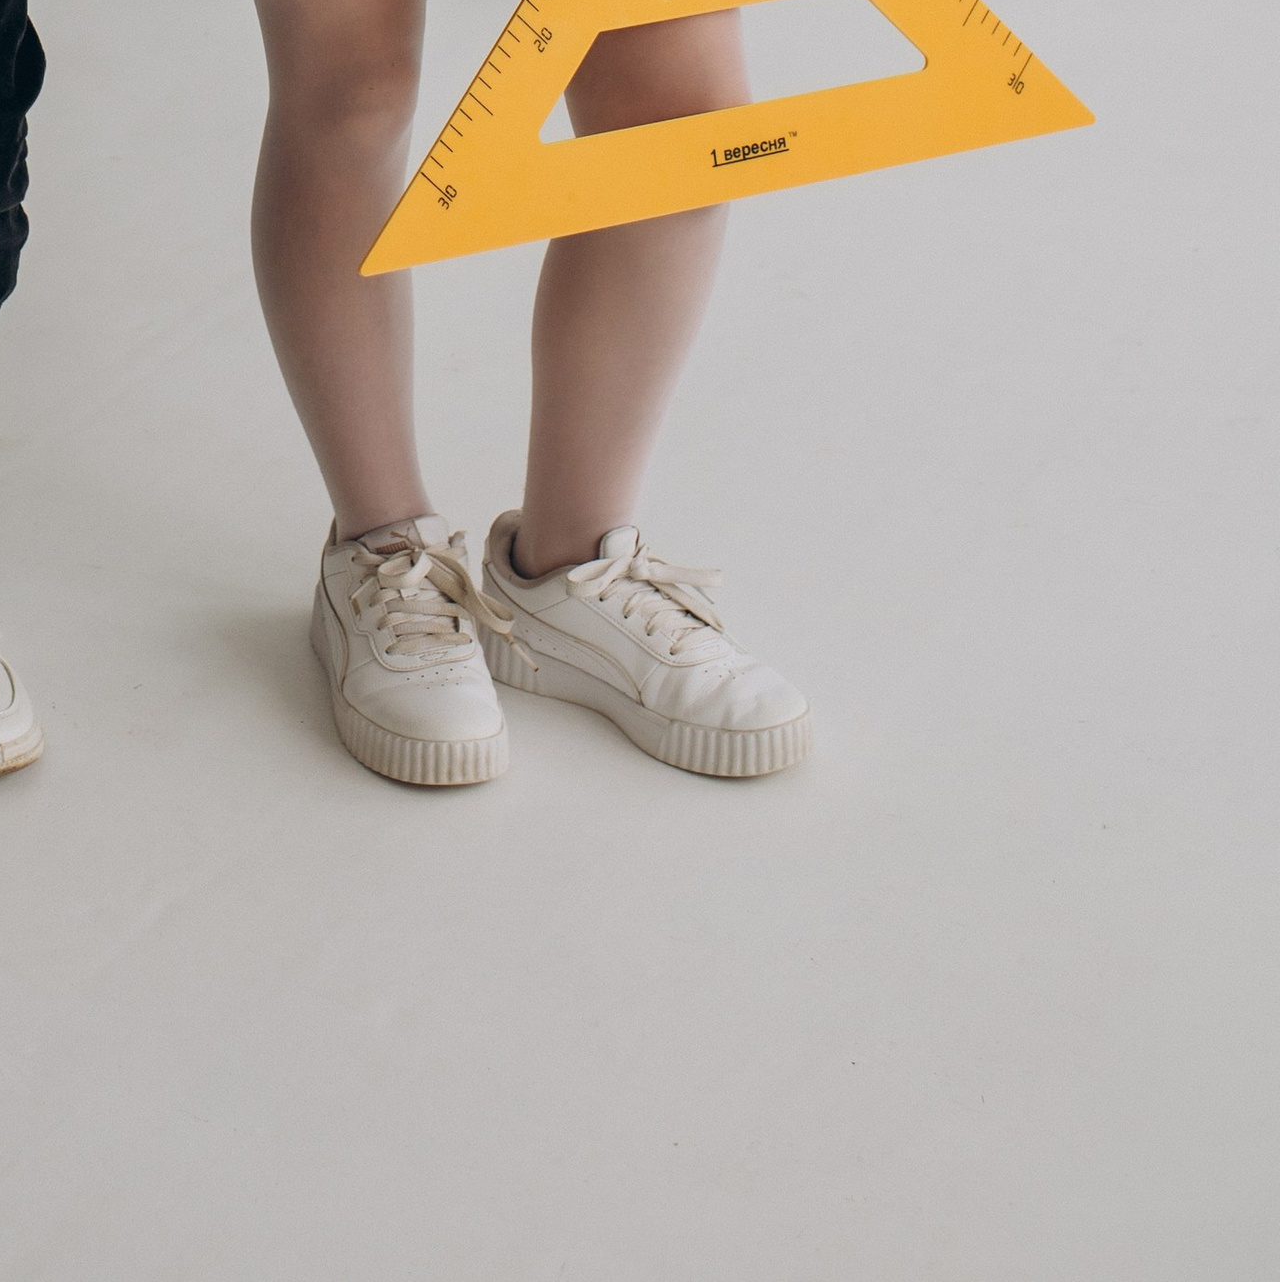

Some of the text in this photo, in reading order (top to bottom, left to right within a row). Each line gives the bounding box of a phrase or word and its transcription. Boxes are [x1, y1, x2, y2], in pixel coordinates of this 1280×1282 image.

[533, 26, 553, 53] 20
[1006, 72, 1025, 95] 30
[710, 148, 719, 167] 1
[723, 136, 787, 162] вересня
[437, 184, 458, 210] 30
